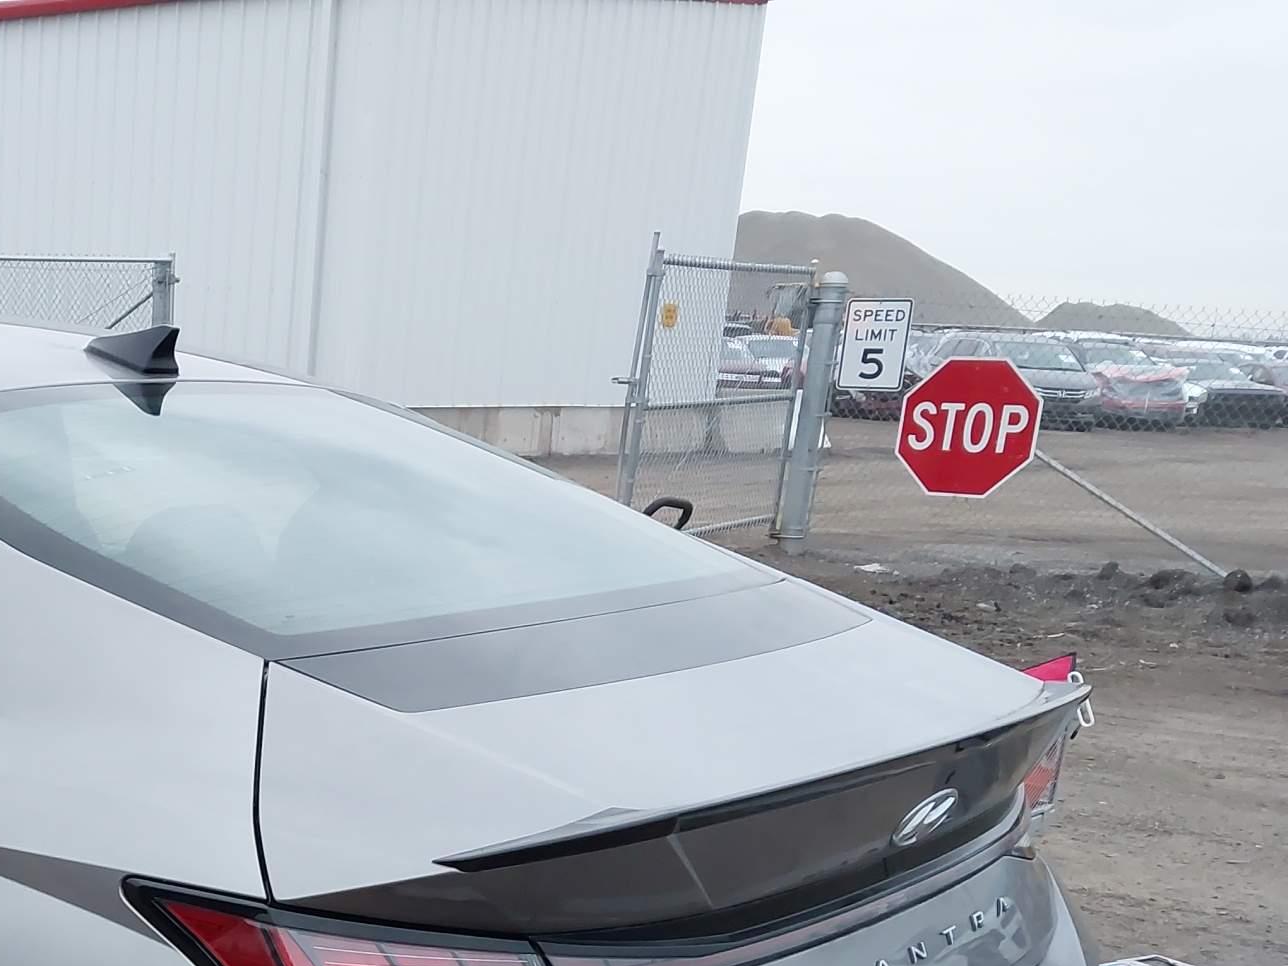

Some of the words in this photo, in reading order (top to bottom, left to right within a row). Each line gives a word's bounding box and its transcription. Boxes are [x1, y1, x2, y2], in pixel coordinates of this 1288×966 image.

[852, 309, 906, 322] SPEED
[855, 328, 898, 342] LIMIT
[858, 348, 884, 380] 5
[907, 401, 1030, 454] STOP
